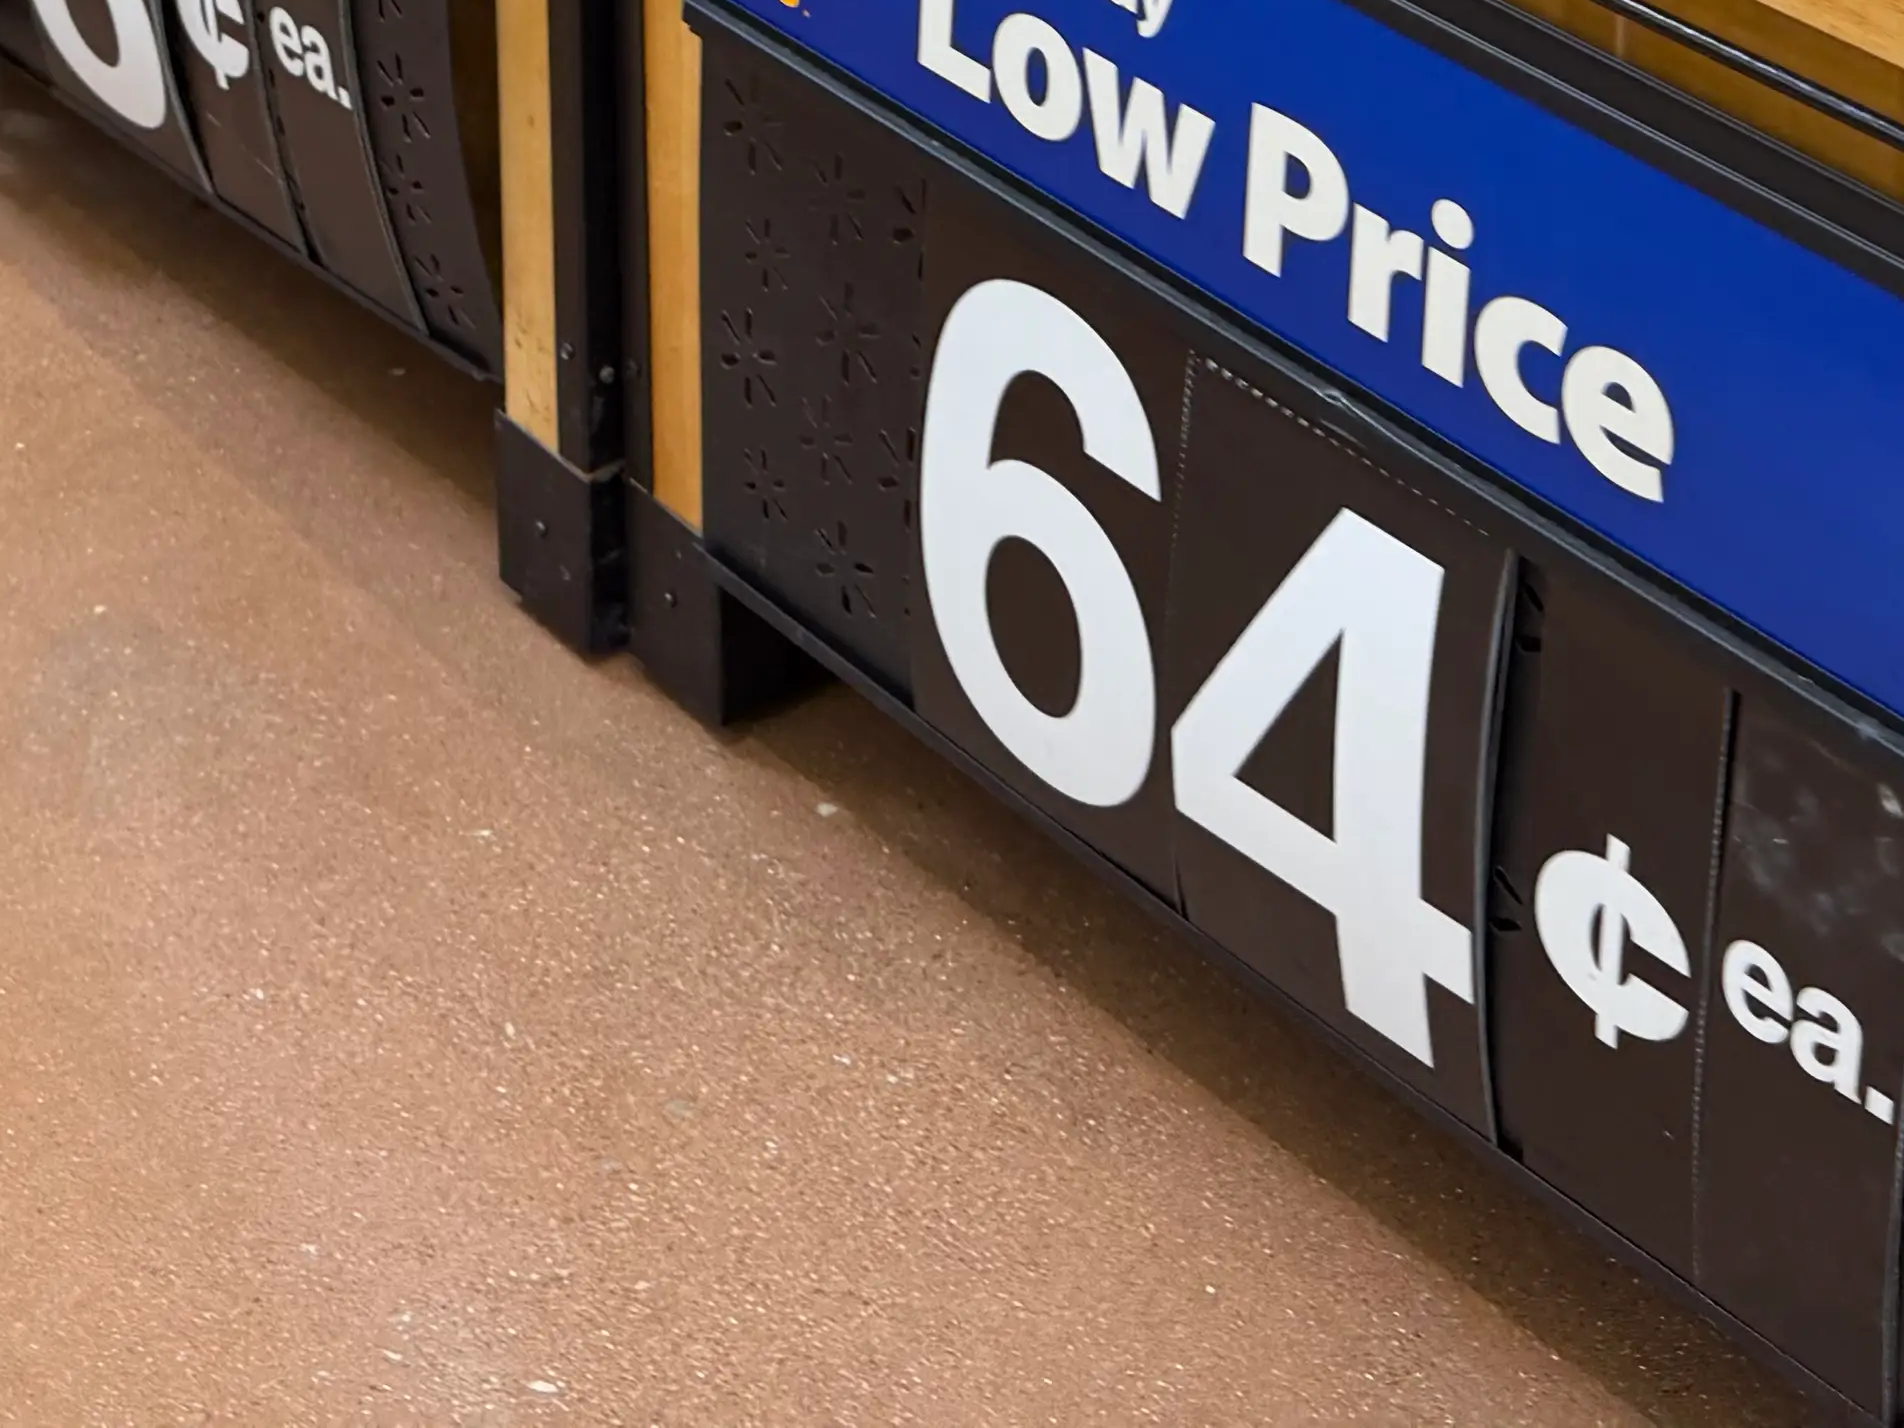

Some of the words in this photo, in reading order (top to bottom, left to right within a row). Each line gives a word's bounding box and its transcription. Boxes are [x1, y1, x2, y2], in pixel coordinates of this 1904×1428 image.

[269, 6, 353, 110] ea.
[1243, 102, 1674, 503] Price
[1722, 939, 1894, 1125] ea.
